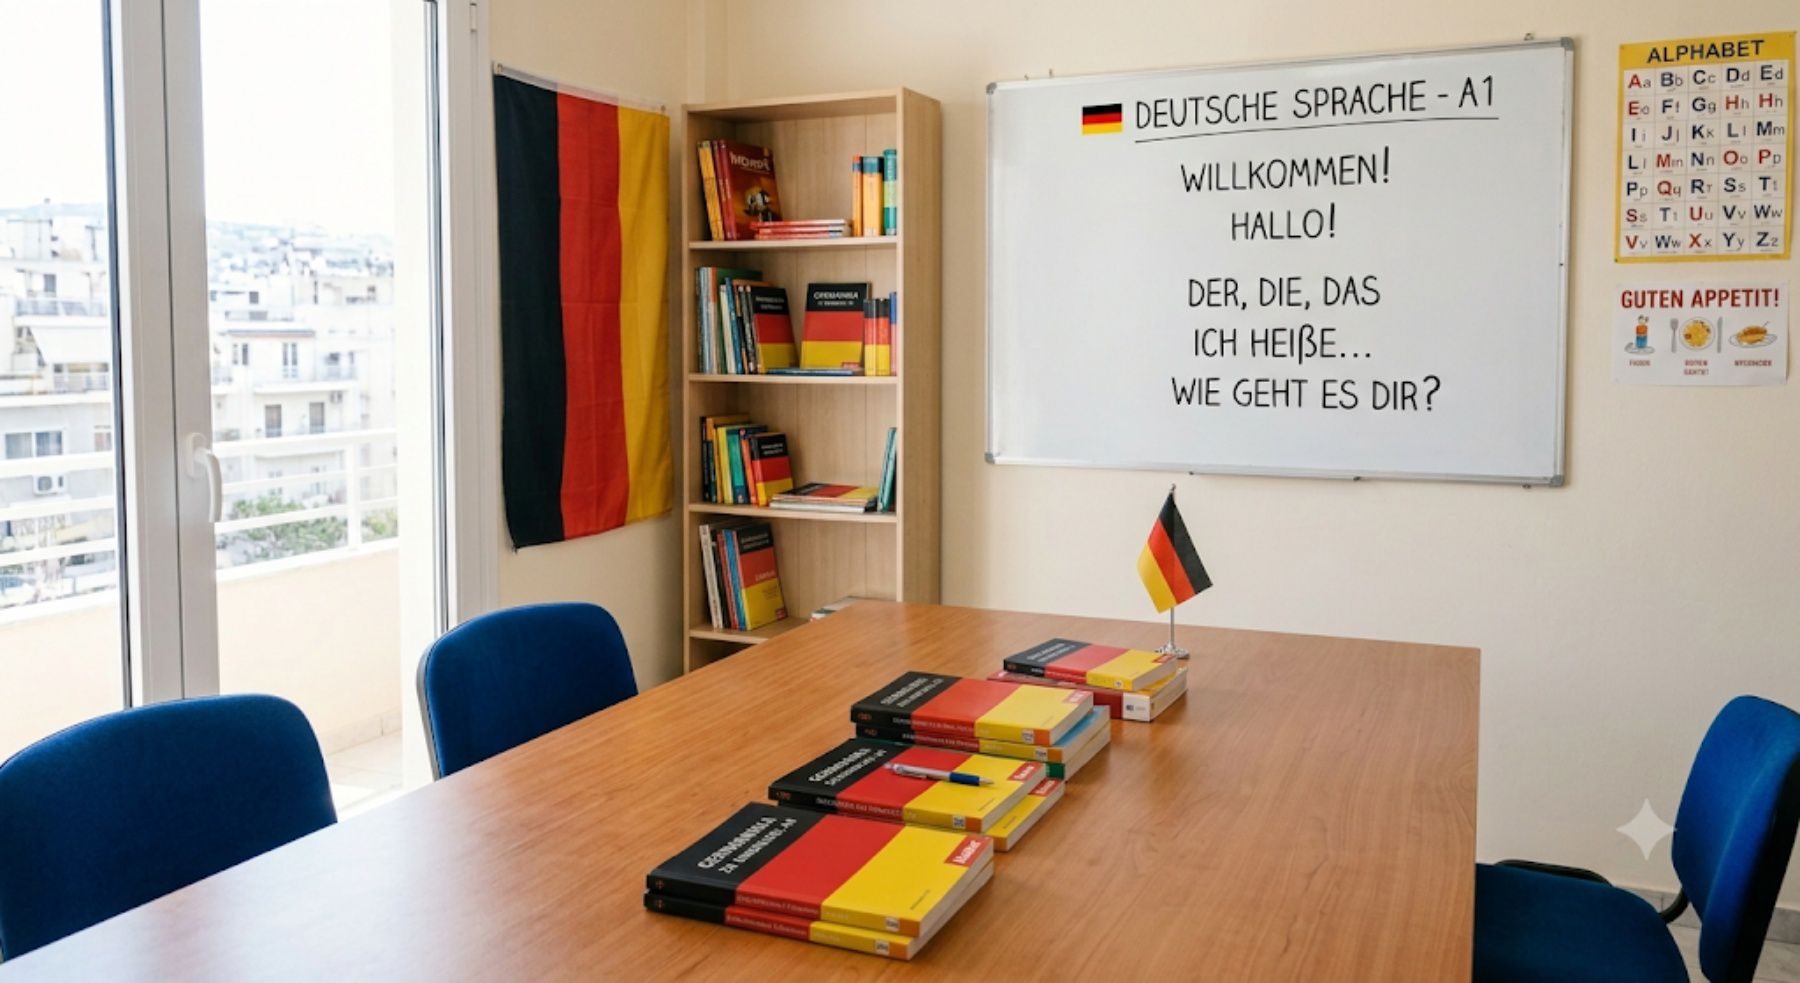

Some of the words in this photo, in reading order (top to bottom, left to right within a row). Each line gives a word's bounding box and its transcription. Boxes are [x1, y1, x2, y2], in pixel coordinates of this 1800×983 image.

[1648, 40, 1764, 63] ALPHABET
[1136, 91, 1278, 129] DEUTSCHE
[1292, 80, 1427, 119] SPRACHE
[1459, 76, 1492, 108] A1
[1181, 146, 1389, 192] WILLKOMMEN!
[1232, 203, 1335, 240] HALLO!
[1189, 278, 1247, 310] DER,
[1260, 277, 1310, 310] DIE,
[1324, 275, 1380, 306] DAS
[1621, 289, 1683, 308] GUTEN
[1691, 288, 1779, 307] APPETIT!
[1195, 328, 1236, 357] ICH
[1251, 324, 1370, 365] HEIßE...
[1172, 377, 1220, 406] WIE
[1233, 378, 1308, 407] GEHT
[1322, 379, 1358, 410] ES
[1373, 375, 1440, 411] DIR?
